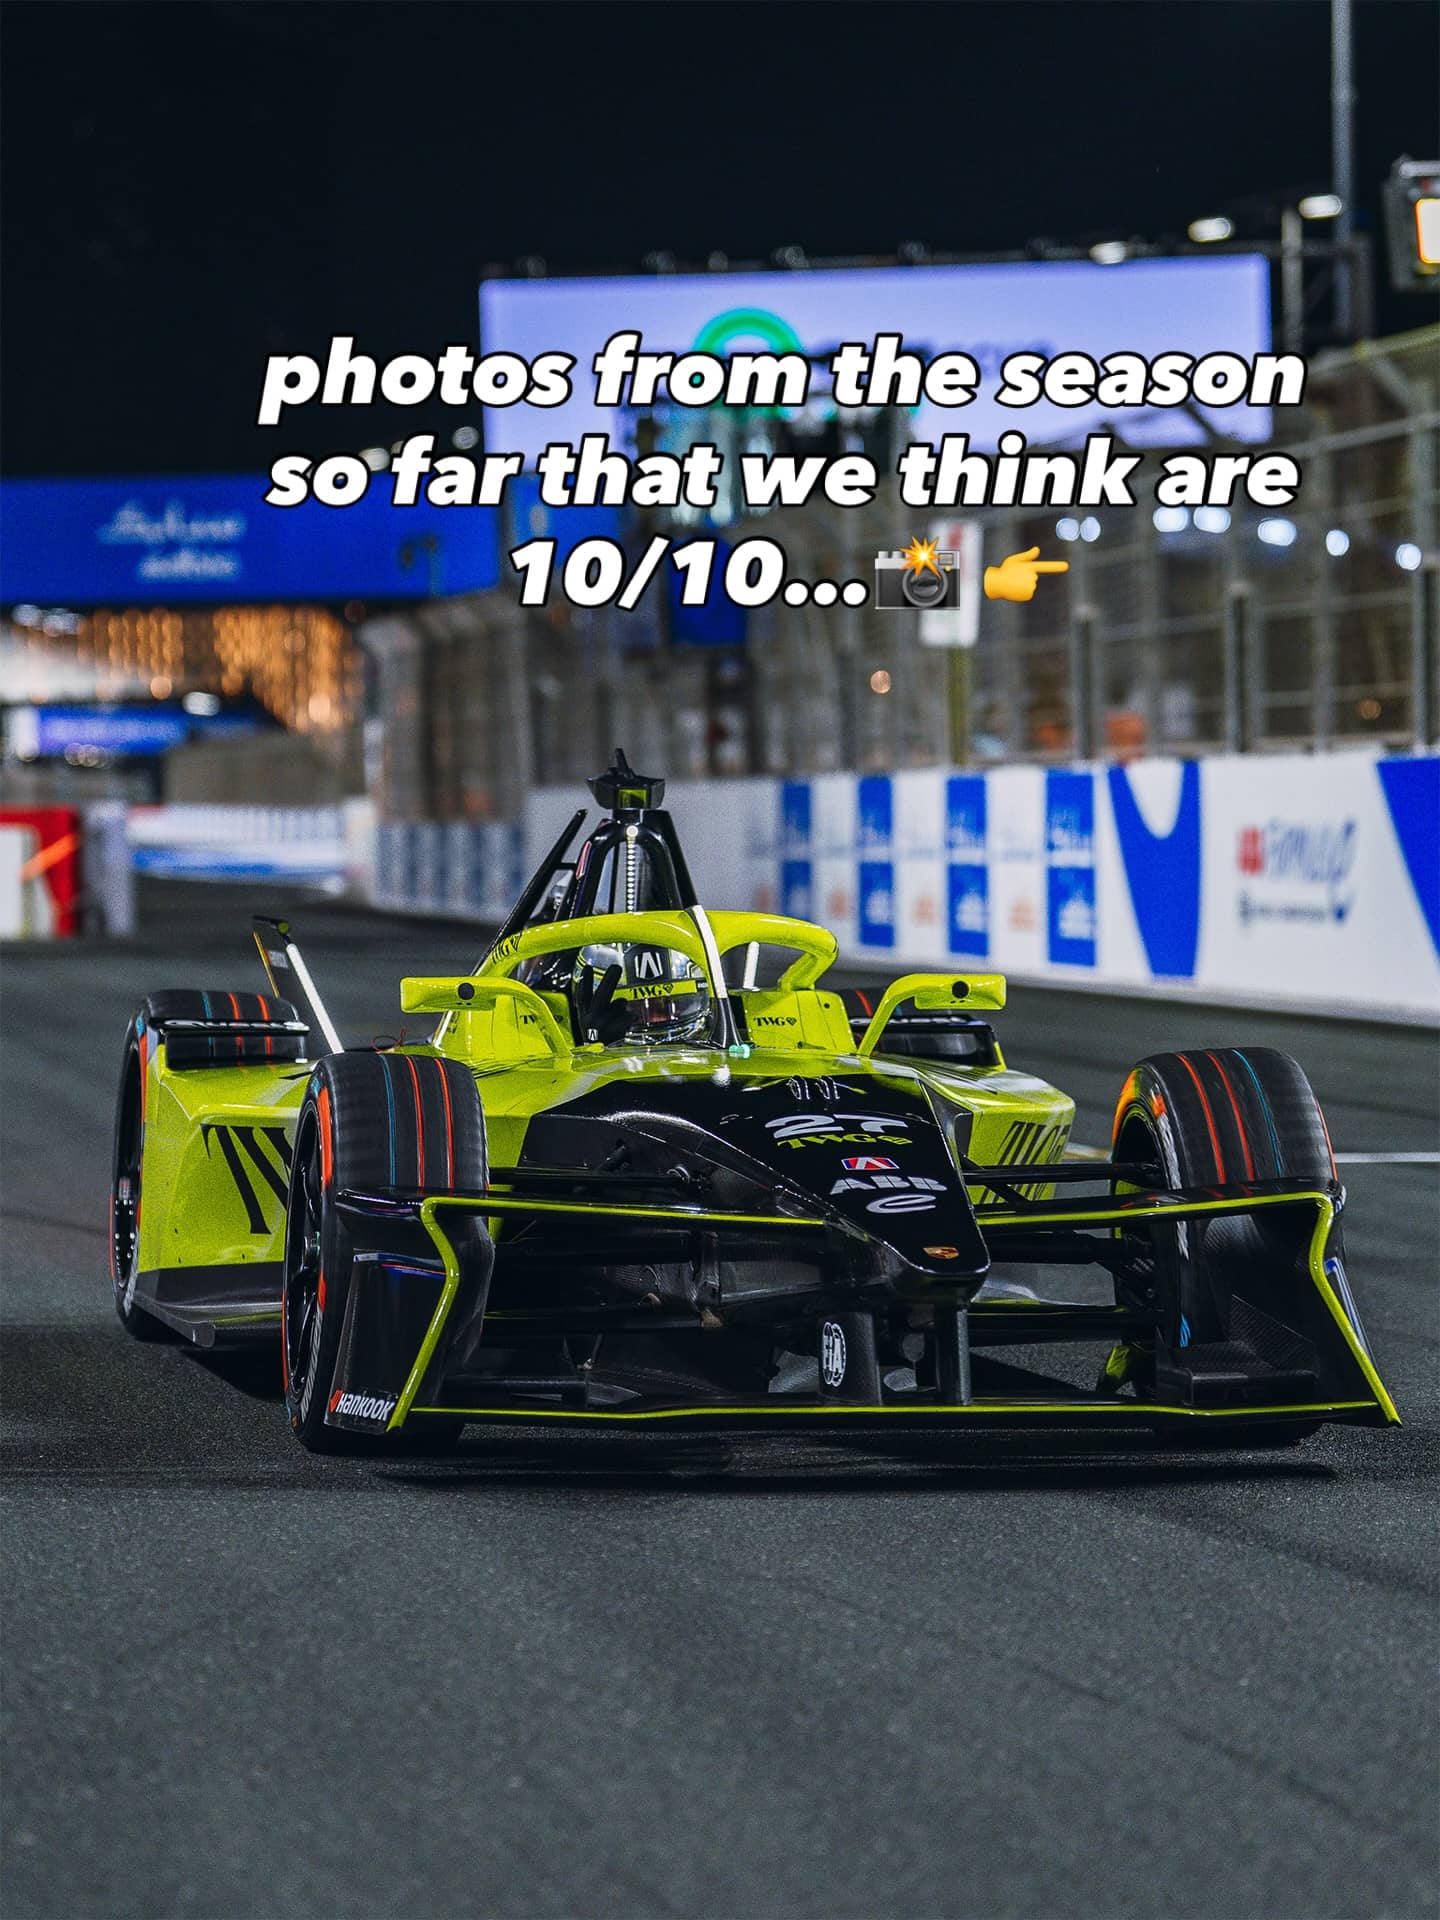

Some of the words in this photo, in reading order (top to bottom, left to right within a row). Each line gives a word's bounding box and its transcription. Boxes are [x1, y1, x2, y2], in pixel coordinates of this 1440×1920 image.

[629, 984, 663, 999] TWG
[752, 1016, 787, 1028] TWG
[764, 1113, 909, 1139] 27
[776, 1133, 877, 1150] TWG
[829, 1175, 949, 1196] ABB
